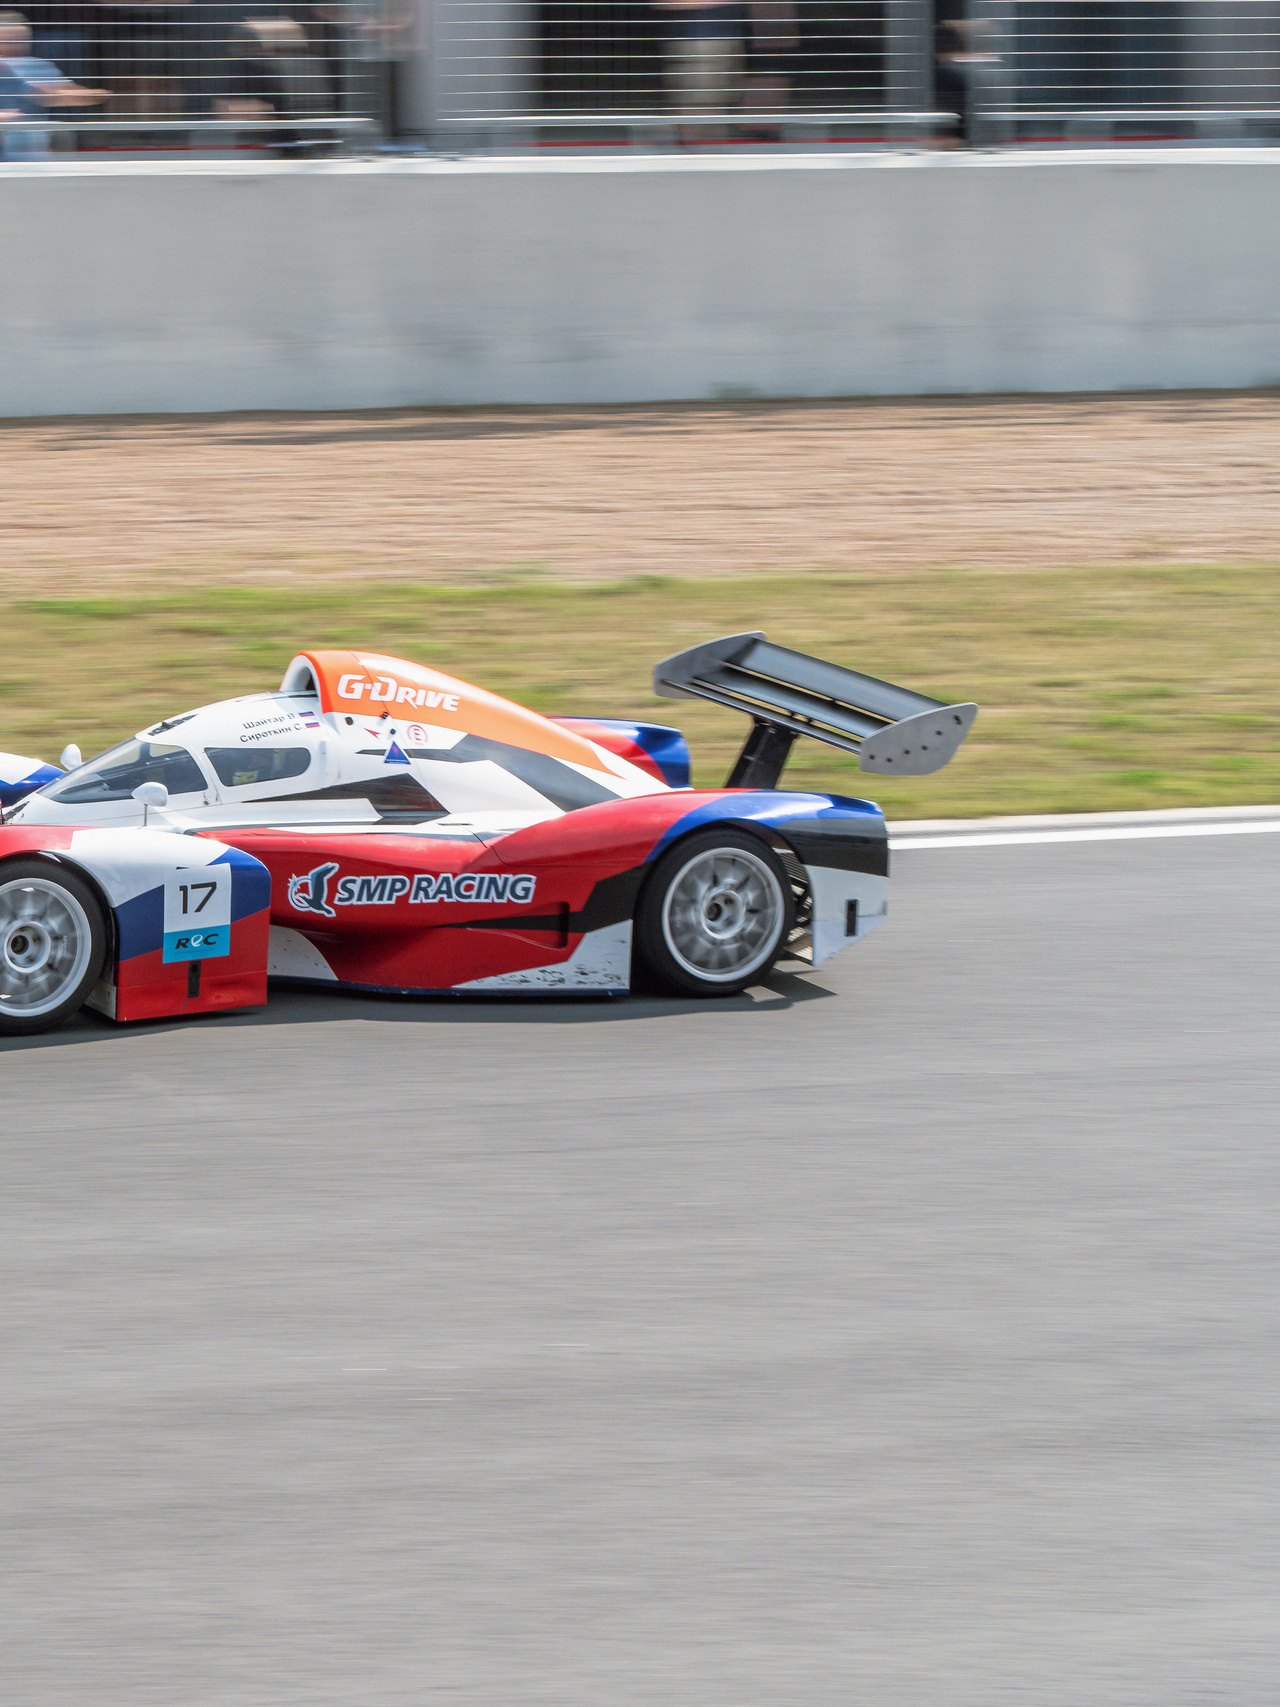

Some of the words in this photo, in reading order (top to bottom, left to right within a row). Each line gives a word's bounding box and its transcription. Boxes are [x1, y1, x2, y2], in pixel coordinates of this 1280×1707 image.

[239, 726, 292, 743] Сироткин
[179, 881, 217, 915] 17
[334, 875, 410, 904] SMP
[409, 873, 537, 903] RACING
